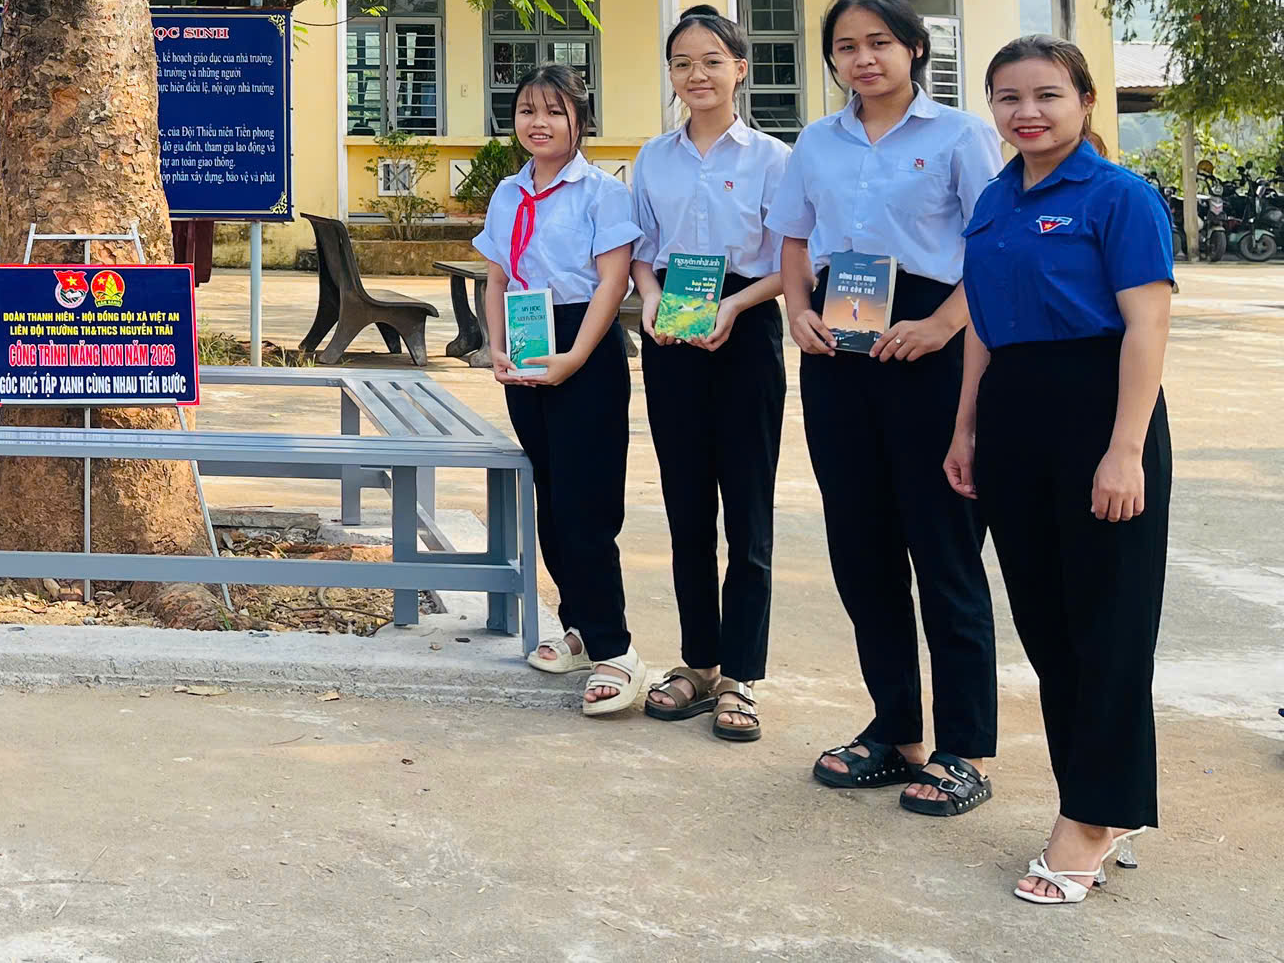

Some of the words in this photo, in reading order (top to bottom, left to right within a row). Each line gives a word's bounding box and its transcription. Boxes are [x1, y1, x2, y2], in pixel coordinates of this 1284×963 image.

[183, 27, 230, 40] SINH
[252, 127, 275, 140] phong
[204, 142, 221, 152] tham
[198, 157, 213, 169] giao
[27, 312, 53, 322] THANH
[55, 311, 75, 322] NIÊN
[81, 311, 95, 323] HỘI
[149, 311, 166, 323] VIỆT
[168, 312, 180, 322] AN
[10, 324, 28, 335] LIÊN
[30, 324, 44, 337] ĐỘI
[46, 324, 79, 335] TRƯỜNG
[80, 326, 118, 335] TH&THCS
[154, 324, 173, 335] TRÃI
[9, 339, 37, 367] CÔNG
[37, 339, 68, 367] TRÌNH
[69, 339, 100, 367] MĂNG
[101, 343, 124, 367] NON
[124, 339, 149, 367] NĂM
[150, 343, 176, 367] 2026
[0, 372, 17, 394] GÓC
[40, 372, 57, 397] TẬP
[59, 376, 84, 394] XANH
[86, 372, 111, 394] CÙNG
[112, 376, 138, 394] NHAU
[139, 371, 160, 393] TIẾN
[161, 372, 186, 393] BƯỚC
